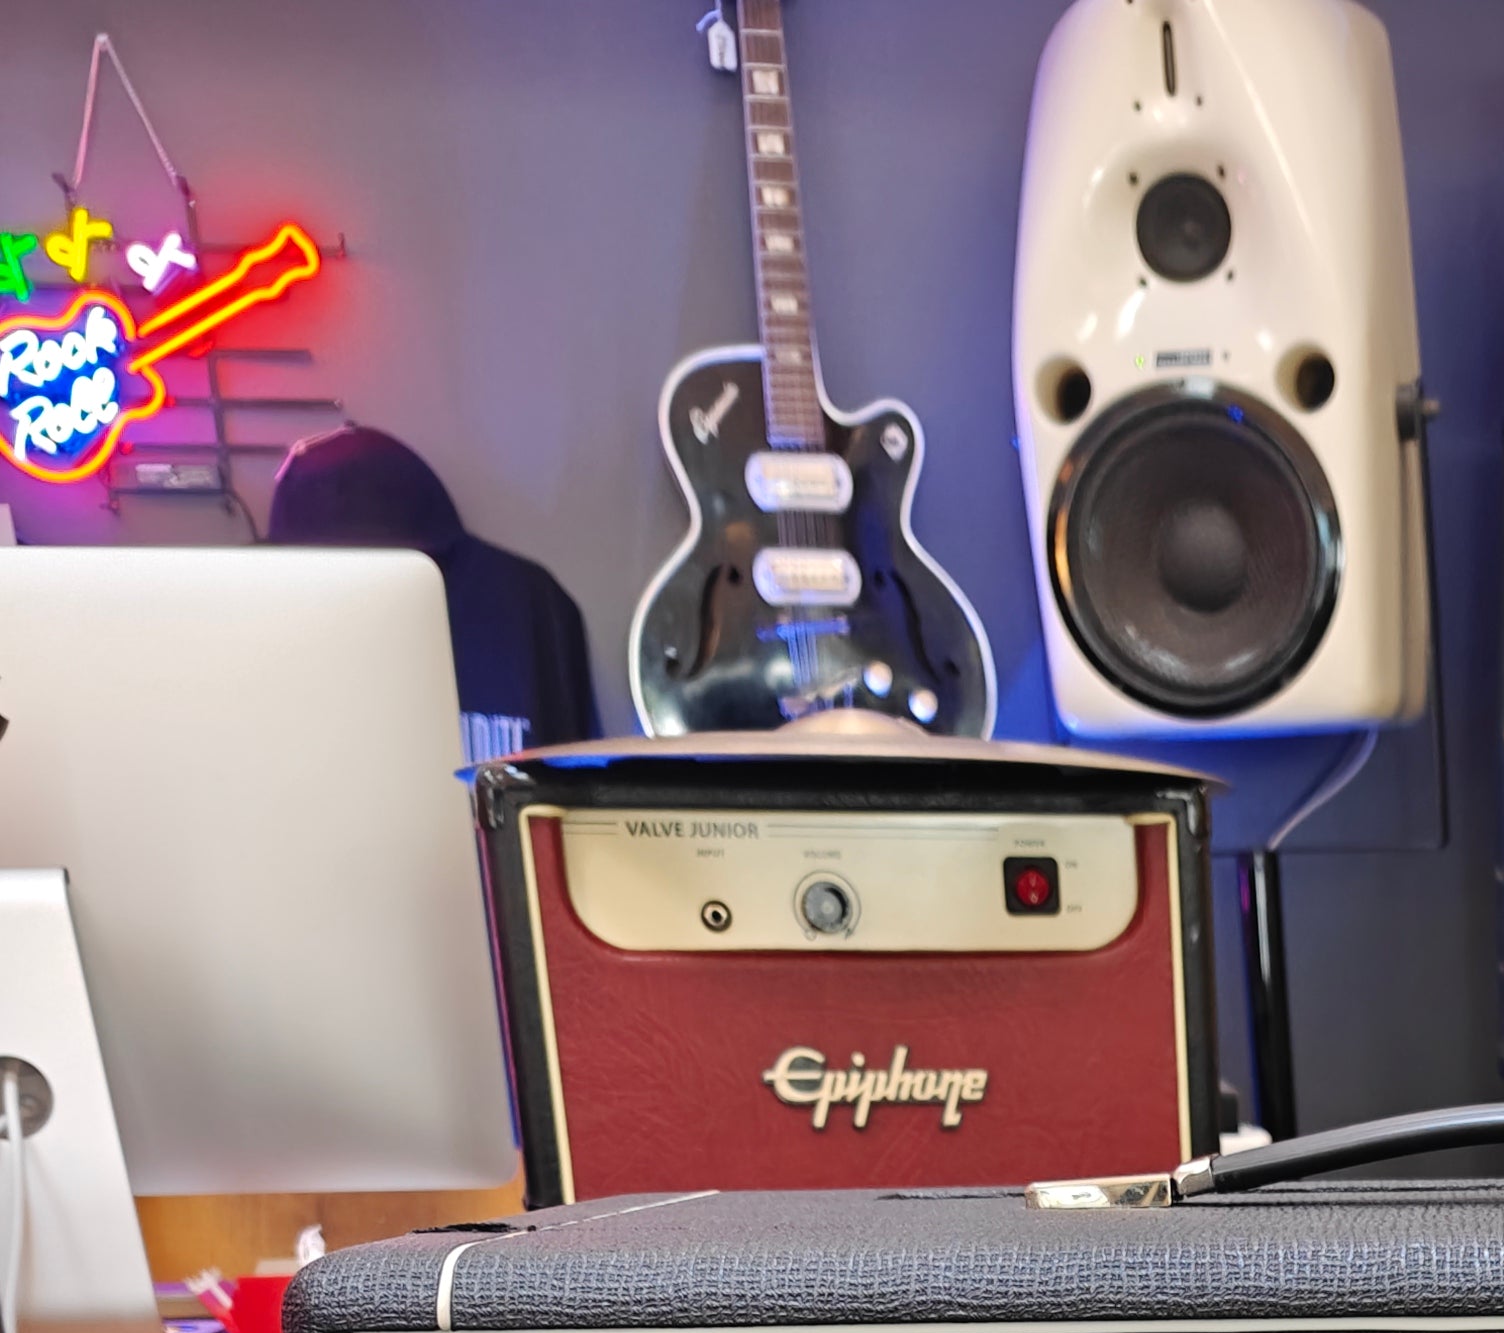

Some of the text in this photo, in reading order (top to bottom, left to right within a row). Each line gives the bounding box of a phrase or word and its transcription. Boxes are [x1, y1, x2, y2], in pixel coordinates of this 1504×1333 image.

[10, 366, 119, 461] Roll
[625, 821, 759, 839] VALVE JUNIOR
[762, 1045, 988, 1129] Epiphone
